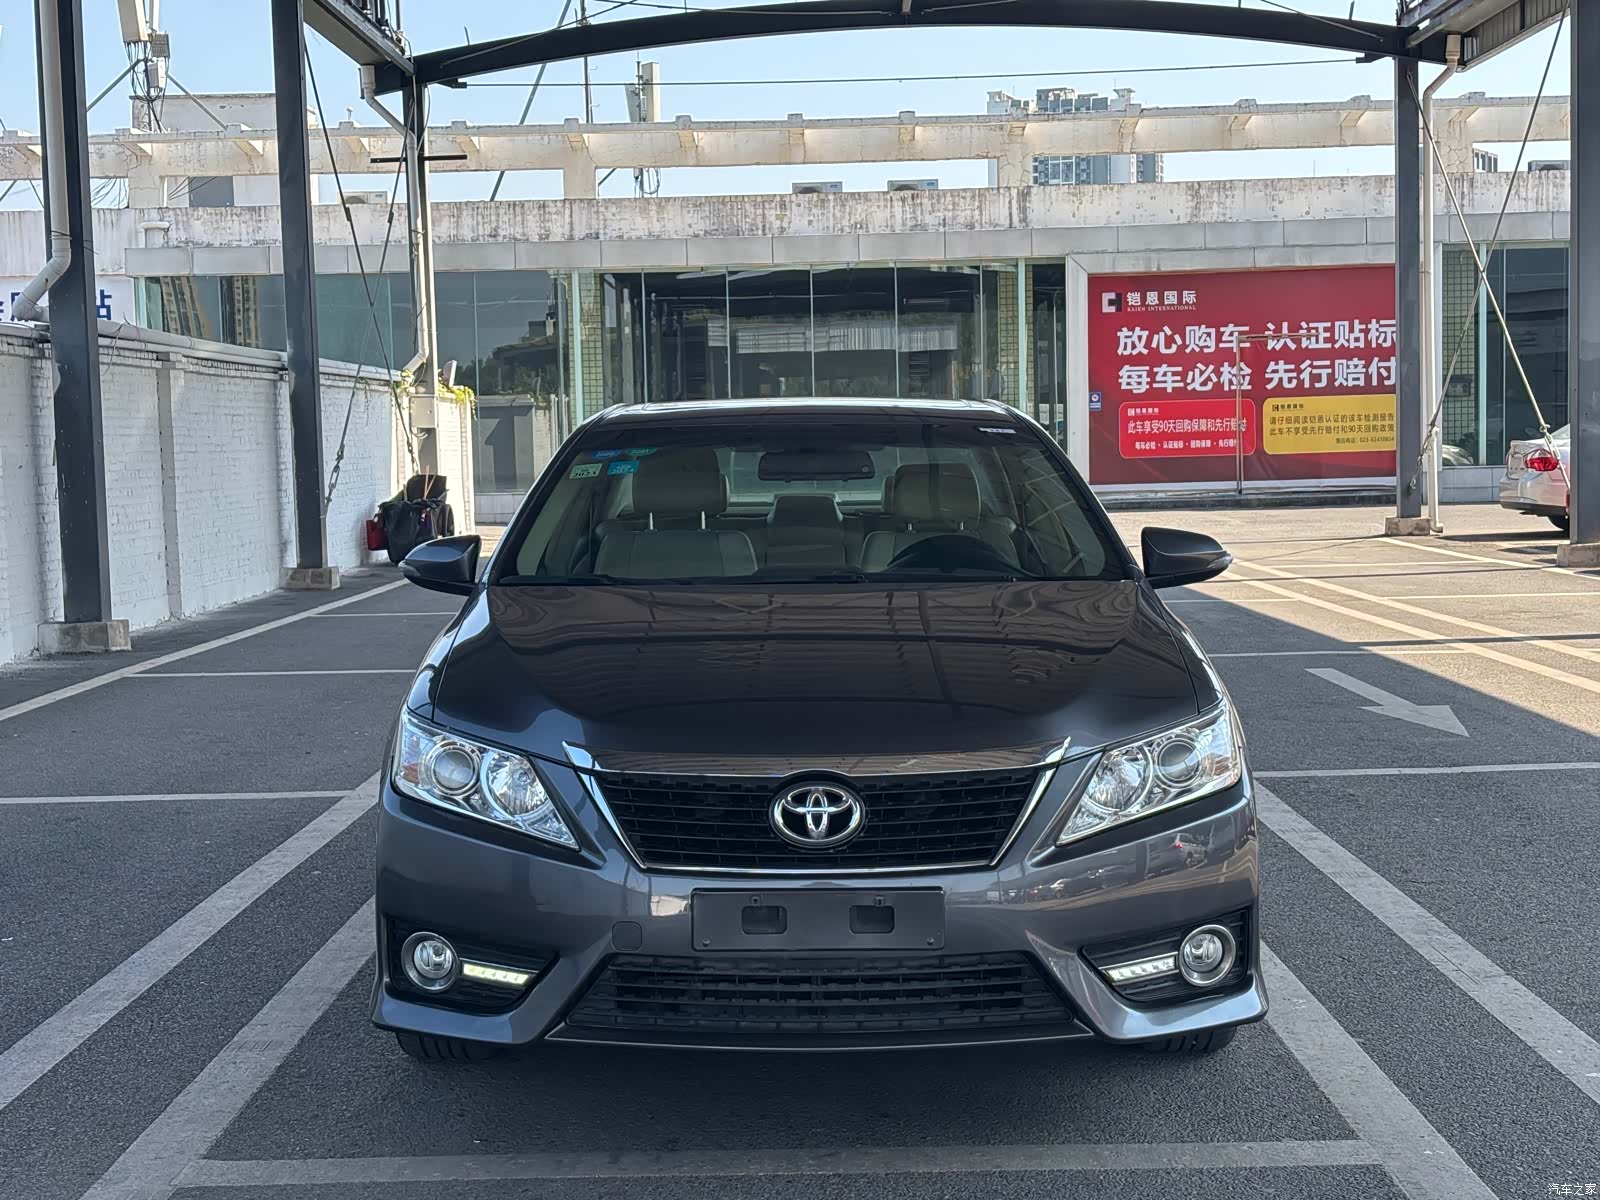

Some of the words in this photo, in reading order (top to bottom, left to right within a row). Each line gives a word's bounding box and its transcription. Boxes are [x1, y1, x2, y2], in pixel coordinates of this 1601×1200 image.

[1126, 290, 1196, 306] 铠恩国际
[1117, 322, 1251, 356] 放心购车
[1265, 319, 1396, 351] 认证贴标
[1117, 361, 1252, 394] 每车必检
[1265, 356, 1397, 390] 先行赔付
